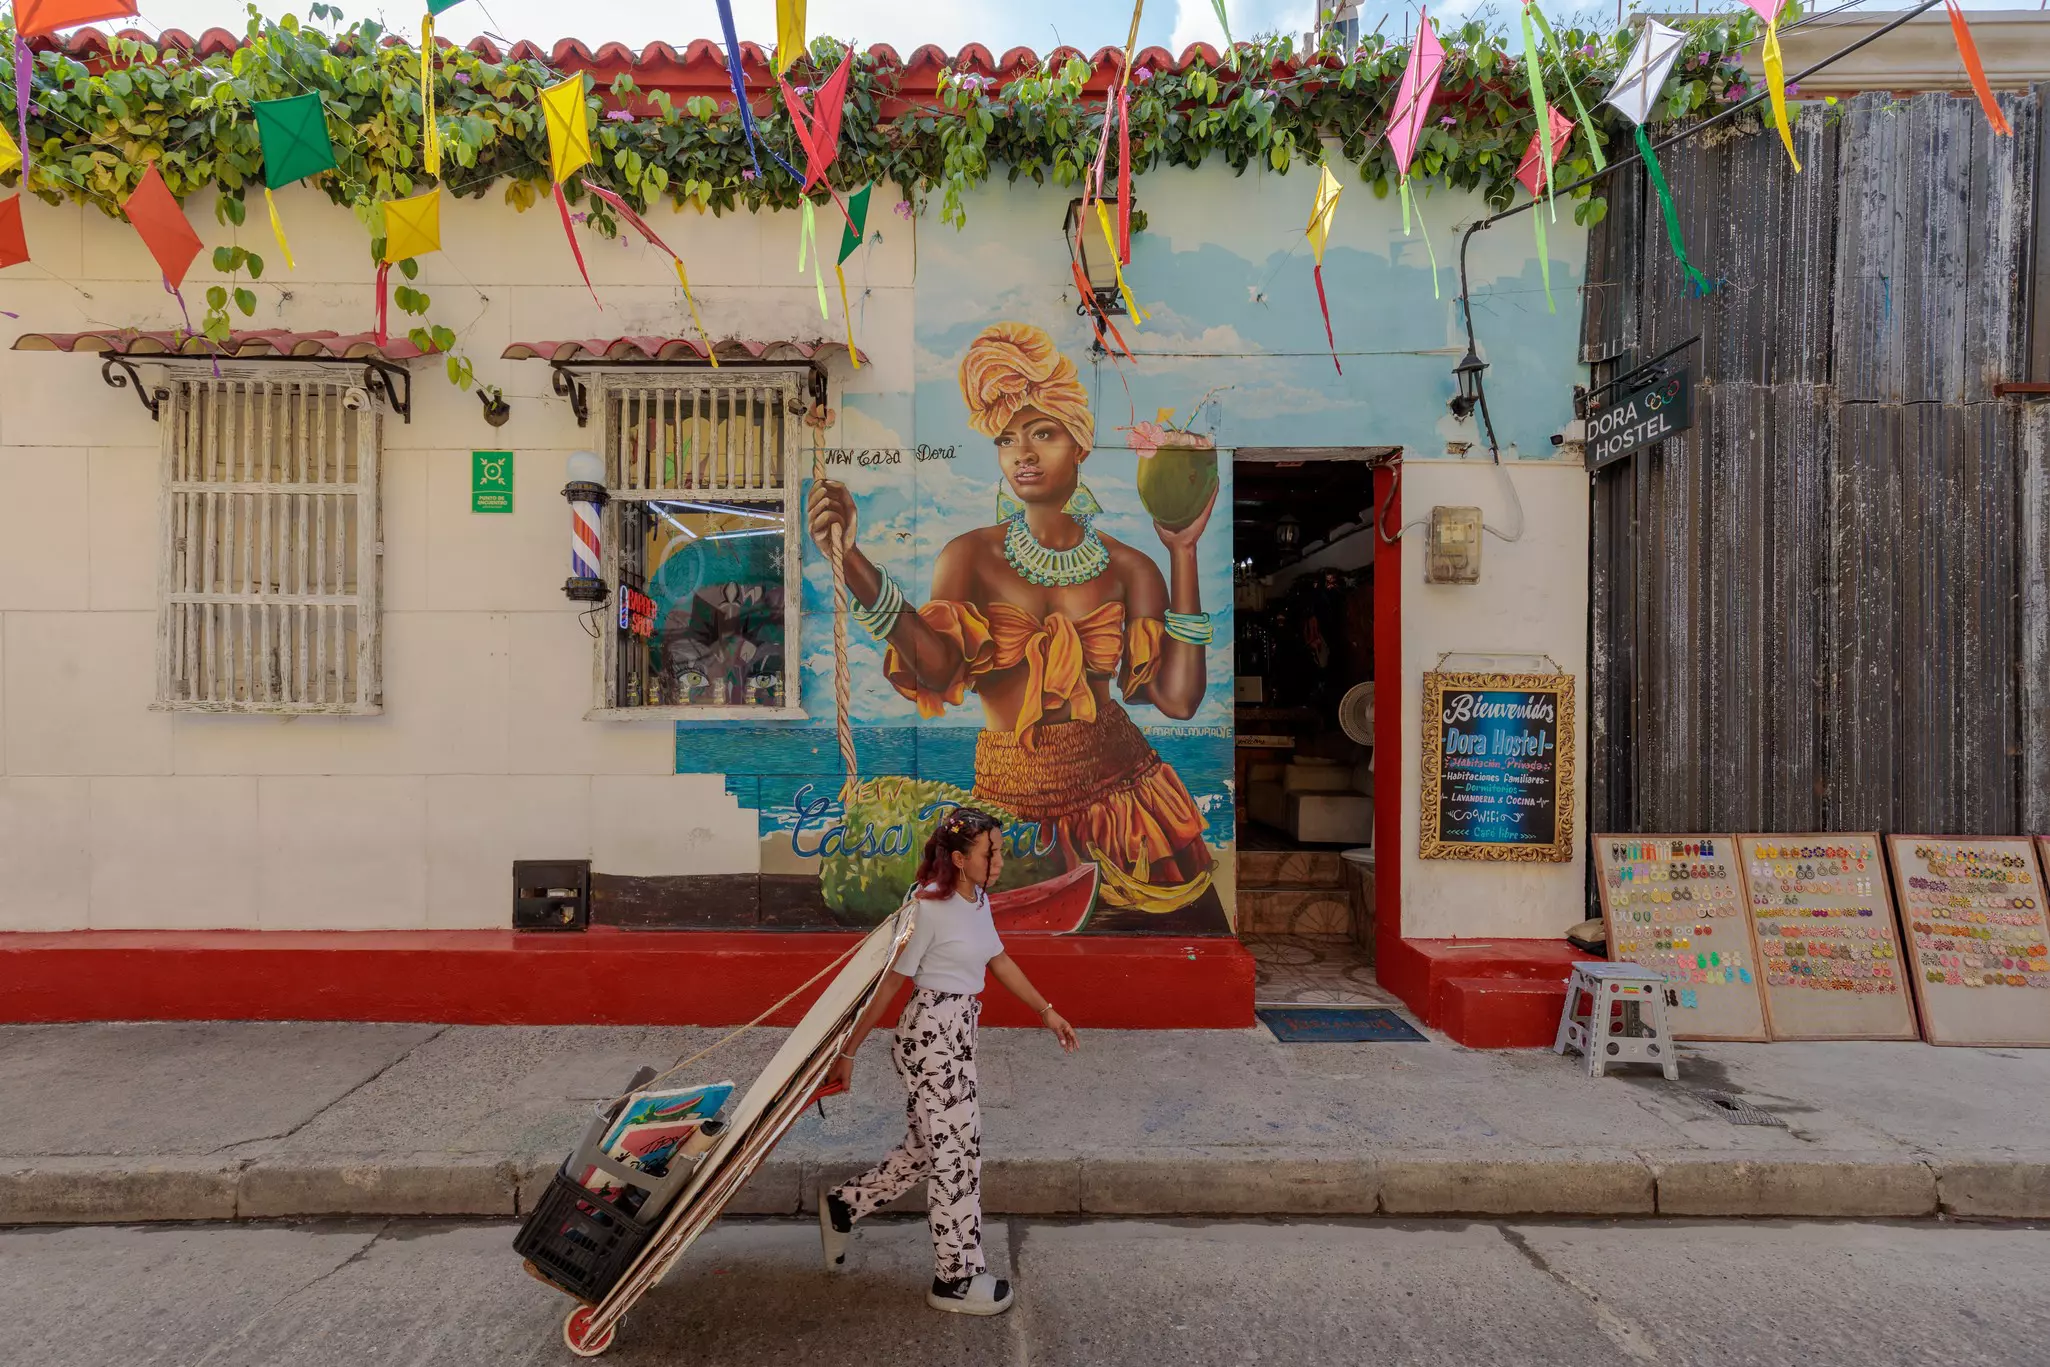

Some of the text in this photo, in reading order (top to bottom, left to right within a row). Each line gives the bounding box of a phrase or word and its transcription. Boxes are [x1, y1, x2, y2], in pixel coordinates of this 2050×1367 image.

[1588, 401, 1637, 442] DORA
[1596, 414, 1672, 460] HOSTEL
[857, 449, 901, 466] Casa
[628, 588, 657, 619] BARBER
[632, 612, 653, 637] SHOP
[1443, 694, 1554, 724] Bienvenidos
[838, 778, 904, 804] NEW
[792, 783, 913, 858] Casa
